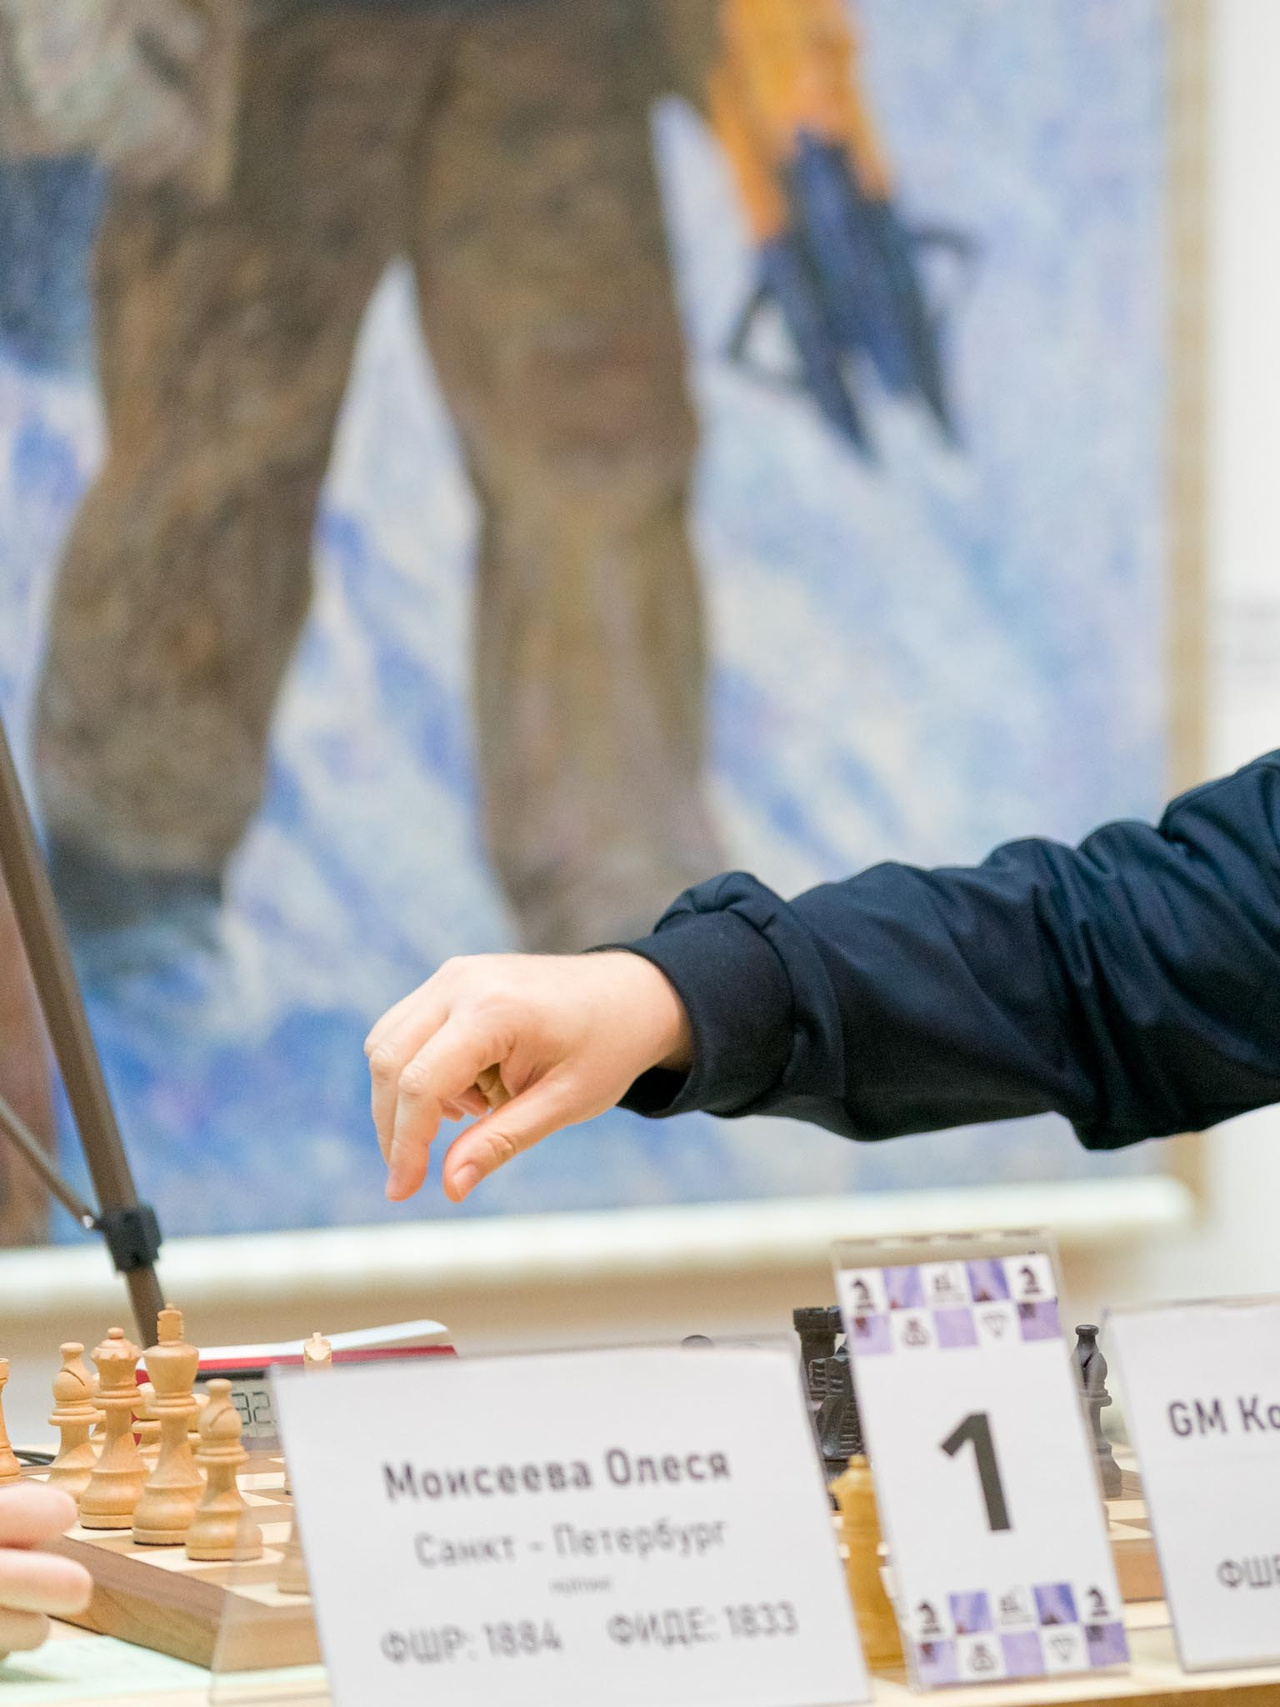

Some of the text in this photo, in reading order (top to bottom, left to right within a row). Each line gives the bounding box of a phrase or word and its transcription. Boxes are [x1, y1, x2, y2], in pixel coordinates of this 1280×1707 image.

[1167, 1397, 1228, 1438] GM
[381, 1446, 731, 1502] Моисеева Олеся
[939, 1411, 1013, 1533] 1
[413, 1532, 515, 1569] Санкт
[552, 1517, 727, 1560] Петербург
[379, 1600, 800, 1665] ФШР: 1884 ФИДЕ: 1833
